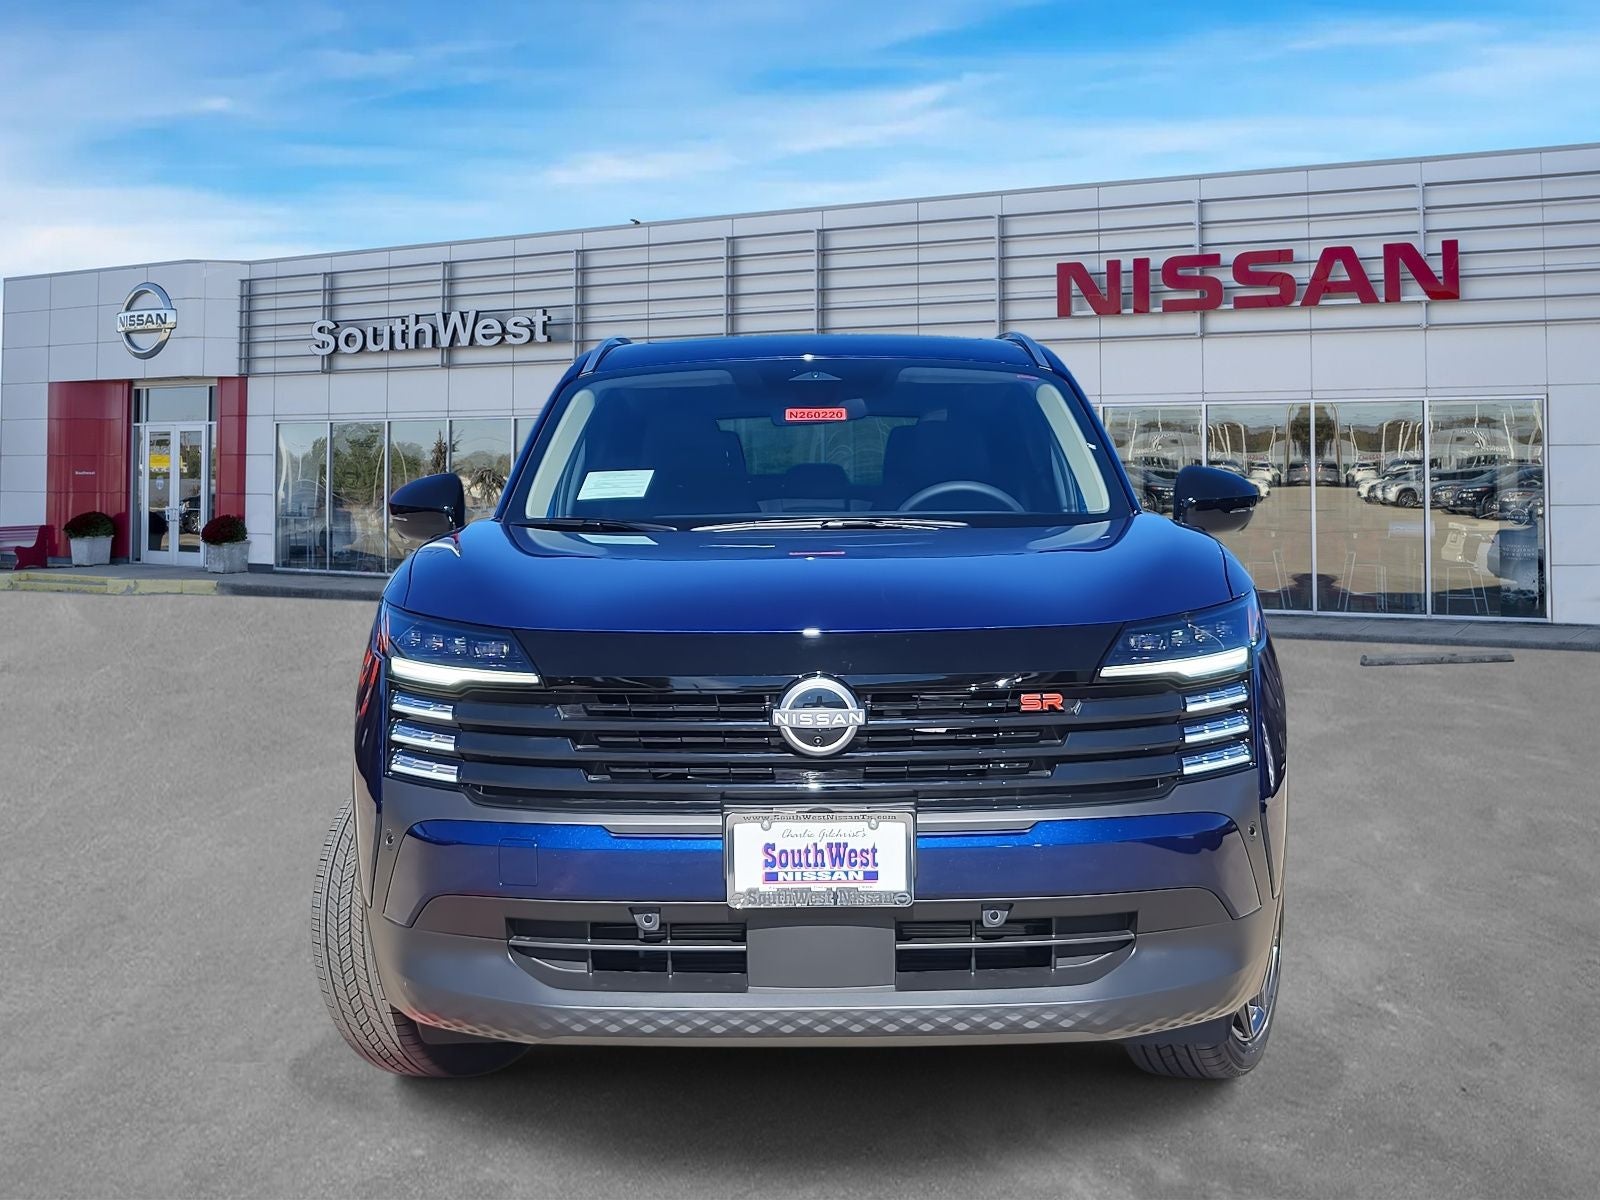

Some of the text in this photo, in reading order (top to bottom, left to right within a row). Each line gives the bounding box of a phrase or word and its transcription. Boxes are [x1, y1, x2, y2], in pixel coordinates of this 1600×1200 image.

[1056, 239, 1461, 318] NISSAN
[119, 312, 168, 328] NISSAN
[308, 309, 552, 356] SouthWest
[789, 411, 843, 419] N260220
[1020, 693, 1065, 711] SR
[774, 711, 863, 726] NISSAN
[763, 841, 879, 870] SouthWest
[777, 870, 864, 881] NISSAN
[747, 888, 894, 906] SouthWest Nissan
